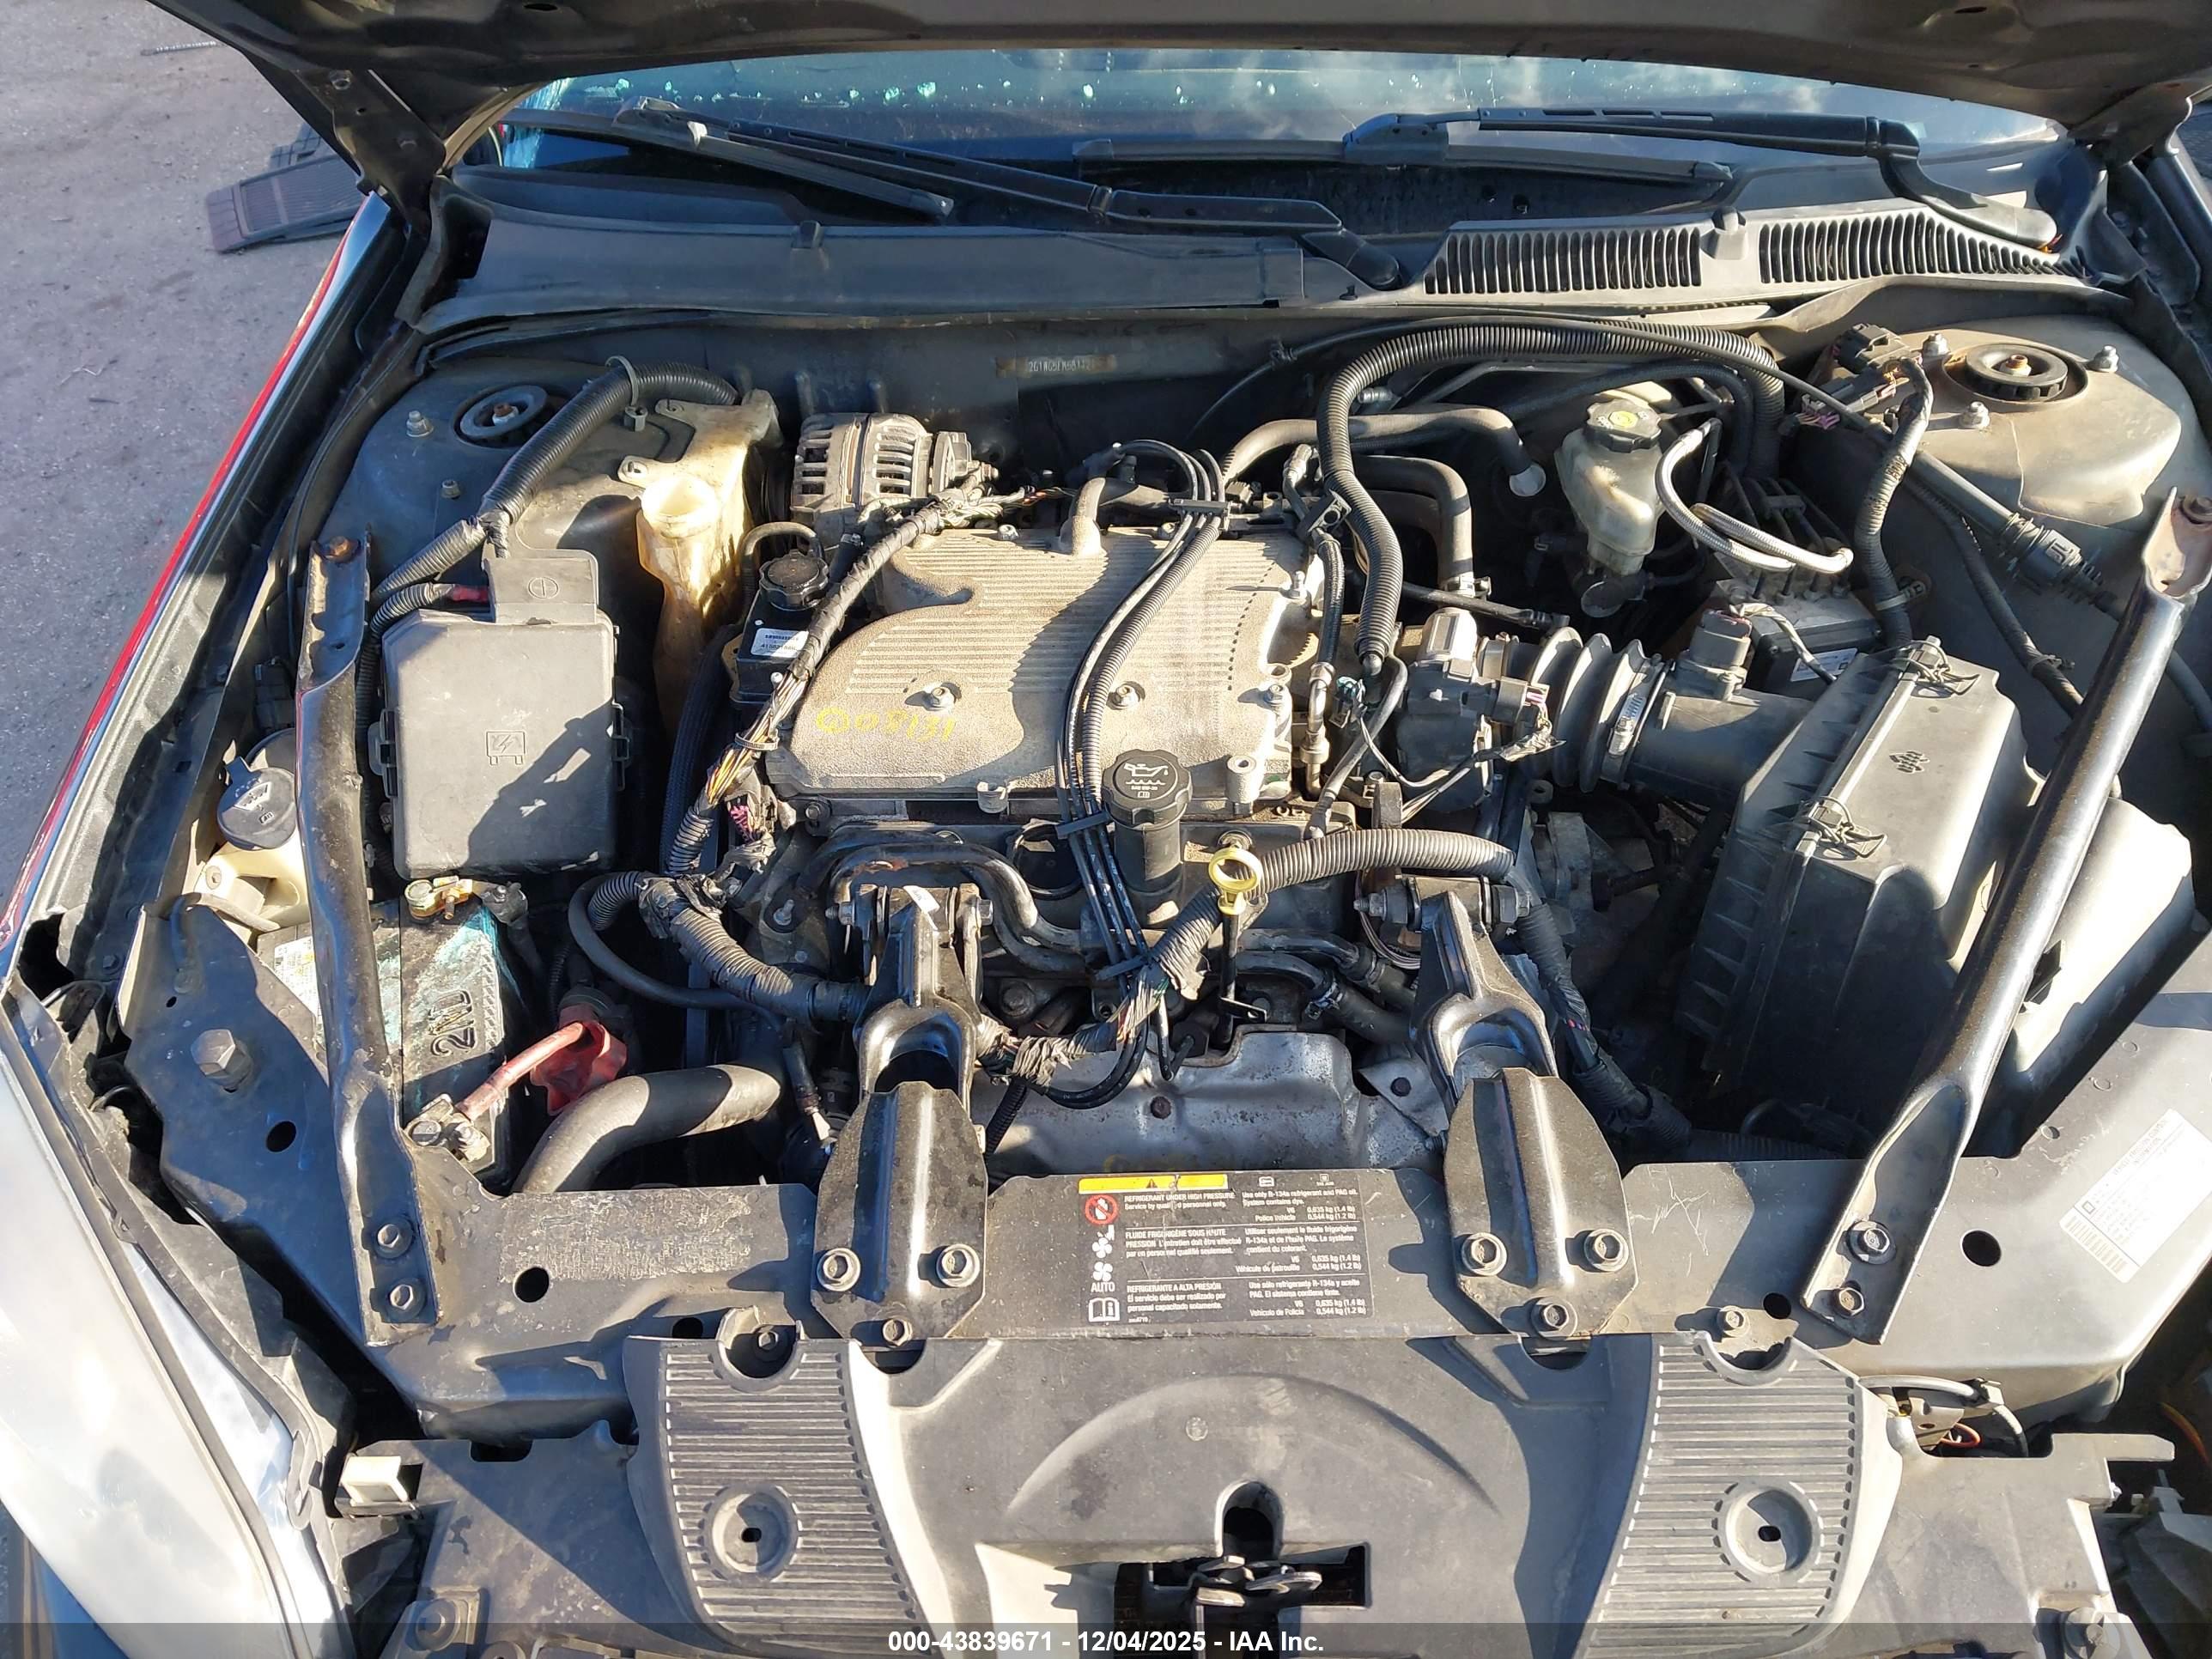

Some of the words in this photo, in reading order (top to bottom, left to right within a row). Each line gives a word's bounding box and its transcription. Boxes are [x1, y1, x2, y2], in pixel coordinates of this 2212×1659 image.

[1267, 1226, 1298, 1235] seulement
[1324, 1224, 1358, 1233] frigorigène
[1177, 1248, 1200, 1256] qualifié
[1330, 1255, 1339, 1263] kg
[1091, 1281, 1115, 1292] AUTO
[1127, 1284, 1172, 1293] REFRIGERANTE
[1194, 1282, 1221, 1291] PRESIÓN
[1275, 1280, 1311, 1289] refrigerante
[1135, 1293, 1158, 1303] servicio
[1127, 1304, 1154, 1313] personal
[1155, 1304, 1188, 1312] capacitado
[1358, 1306, 1367, 1315] lb)
